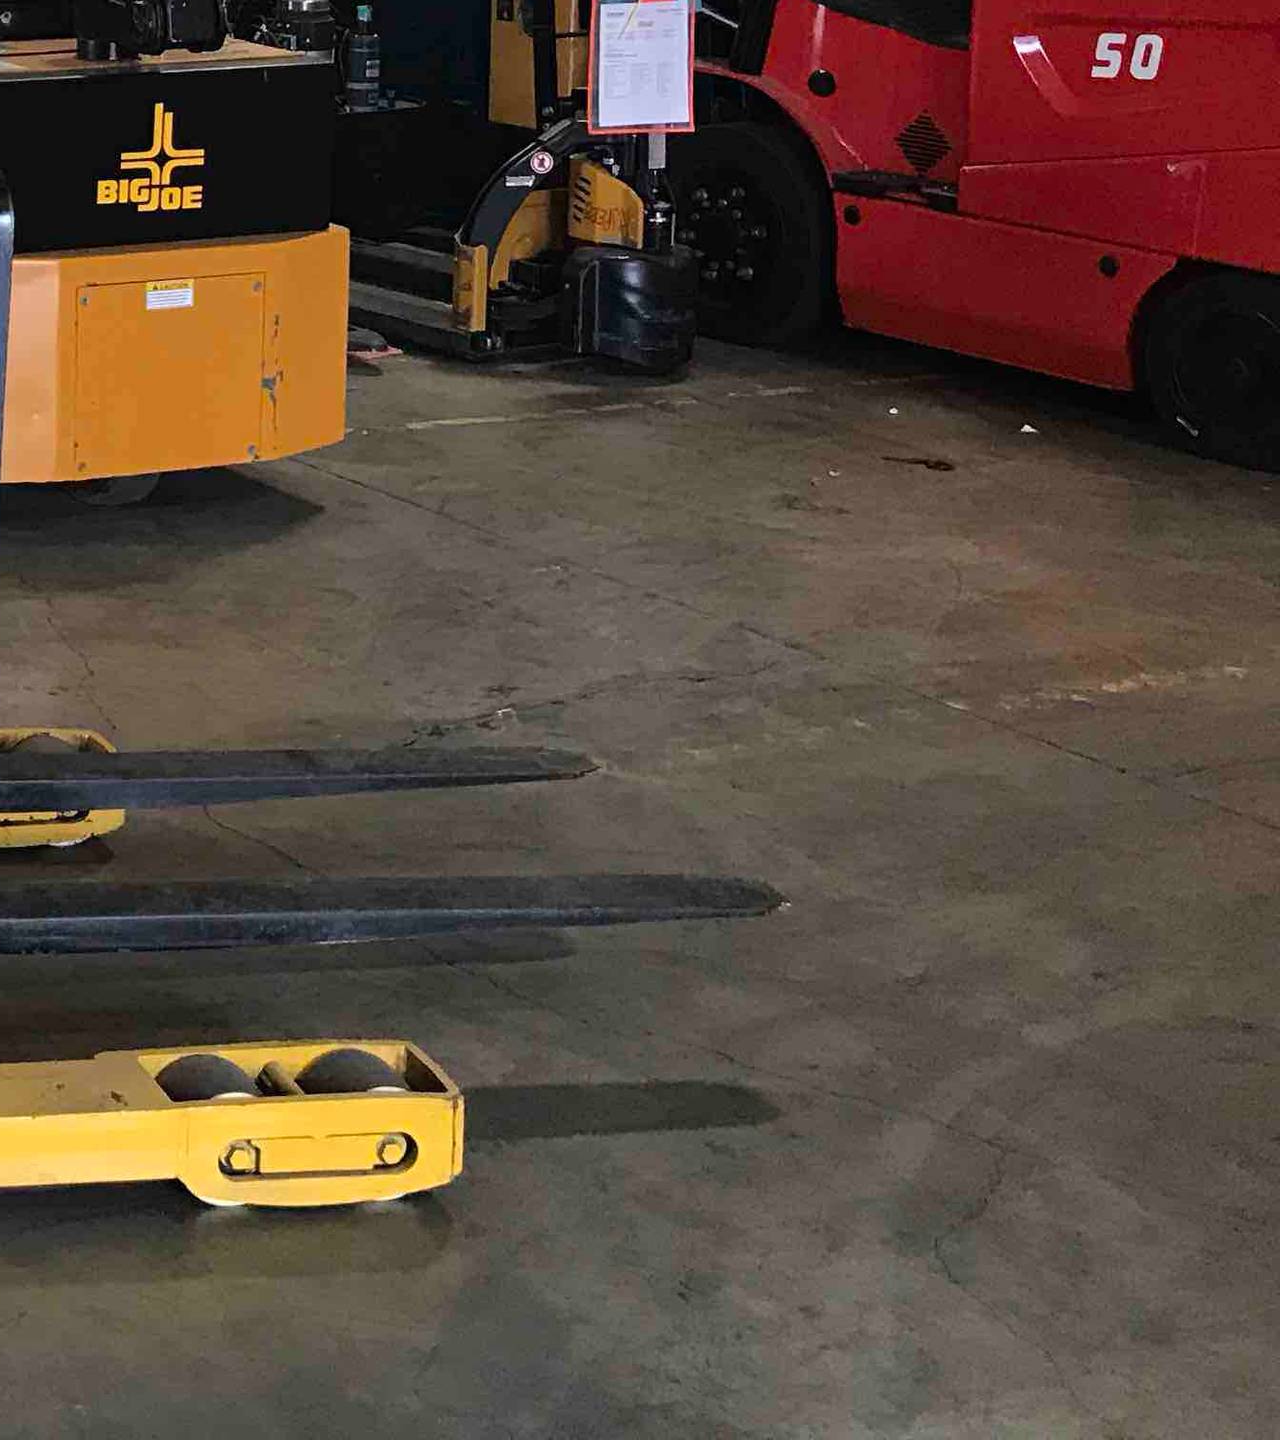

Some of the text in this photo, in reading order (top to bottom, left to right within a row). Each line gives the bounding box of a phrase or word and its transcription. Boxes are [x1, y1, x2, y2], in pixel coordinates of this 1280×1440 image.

[1090, 32, 1164, 80] 50
[96, 178, 203, 212] BIG JOE
